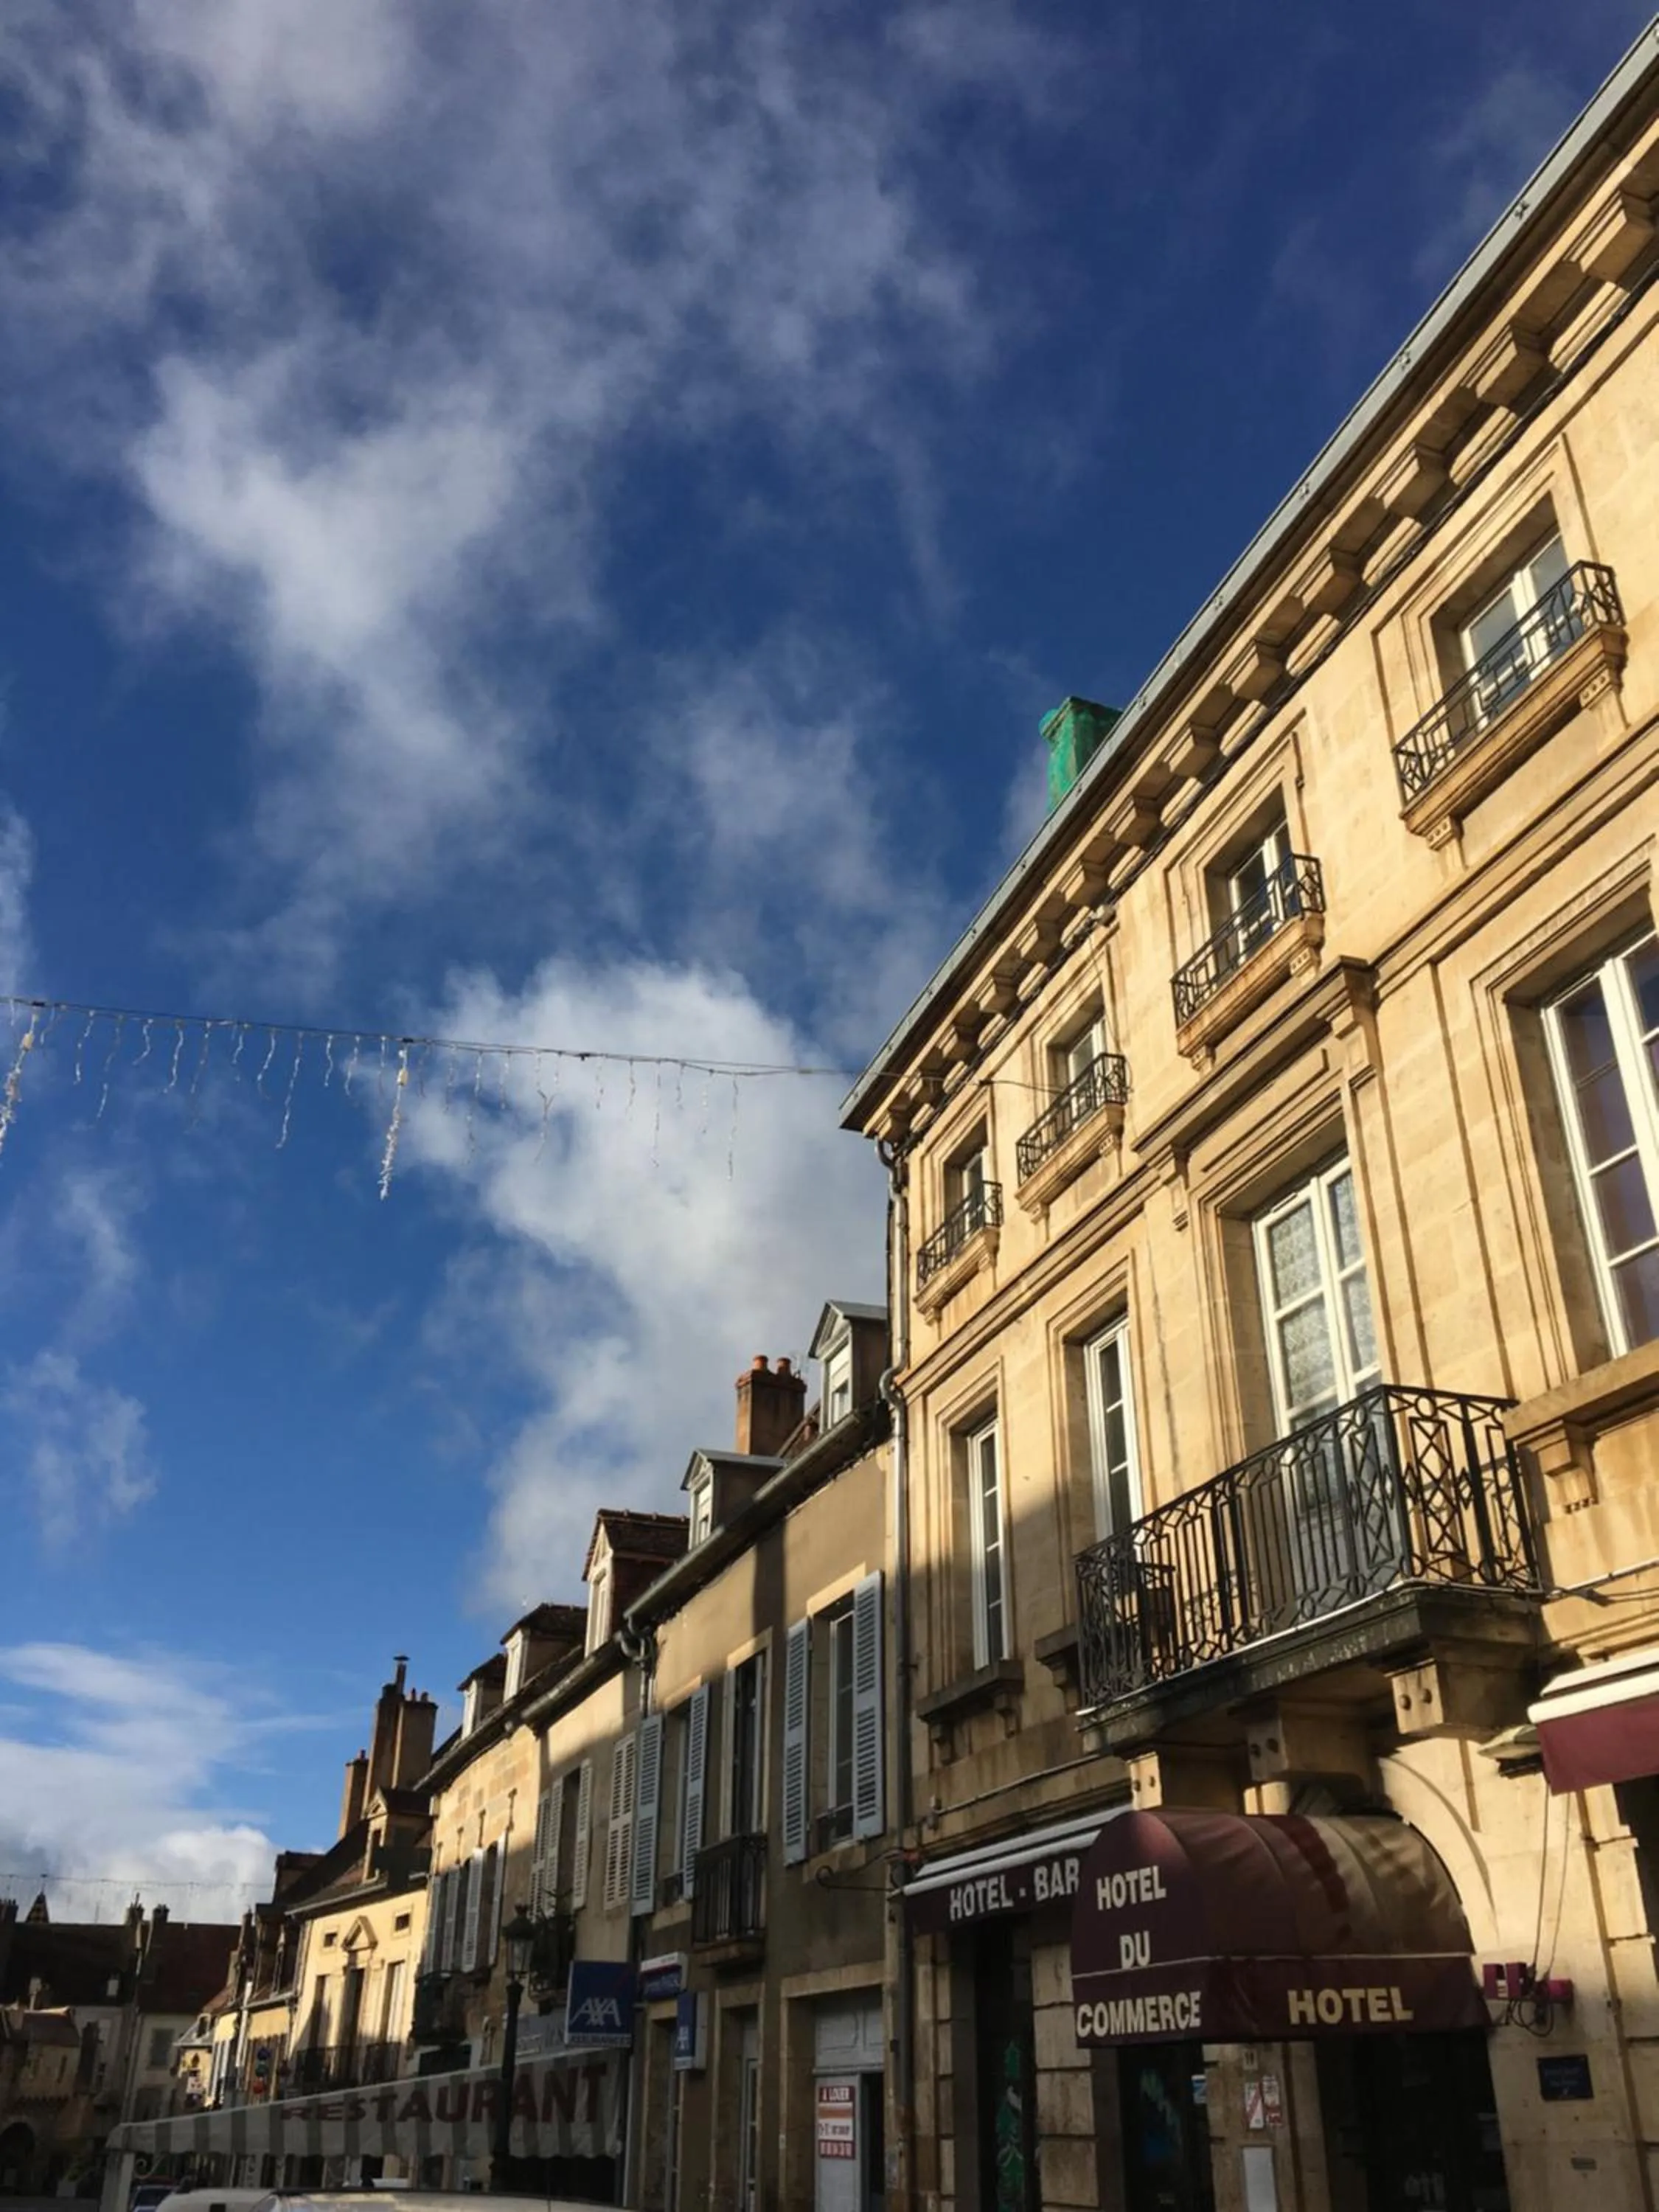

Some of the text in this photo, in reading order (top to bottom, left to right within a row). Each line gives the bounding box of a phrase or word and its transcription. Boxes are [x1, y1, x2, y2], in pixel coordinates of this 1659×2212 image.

[950, 1875, 1014, 1921] HOTEL
[1034, 1857, 1079, 1902] BAR
[1096, 1865, 1166, 1910] HOTEL
[1119, 1930, 1151, 1969] DU
[569, 1997, 622, 2028] AXA
[1077, 1992, 1202, 2037] COMMERCE
[1287, 1987, 1414, 2025] HOTEL
[281, 2063, 607, 2124] RESTAURANT
